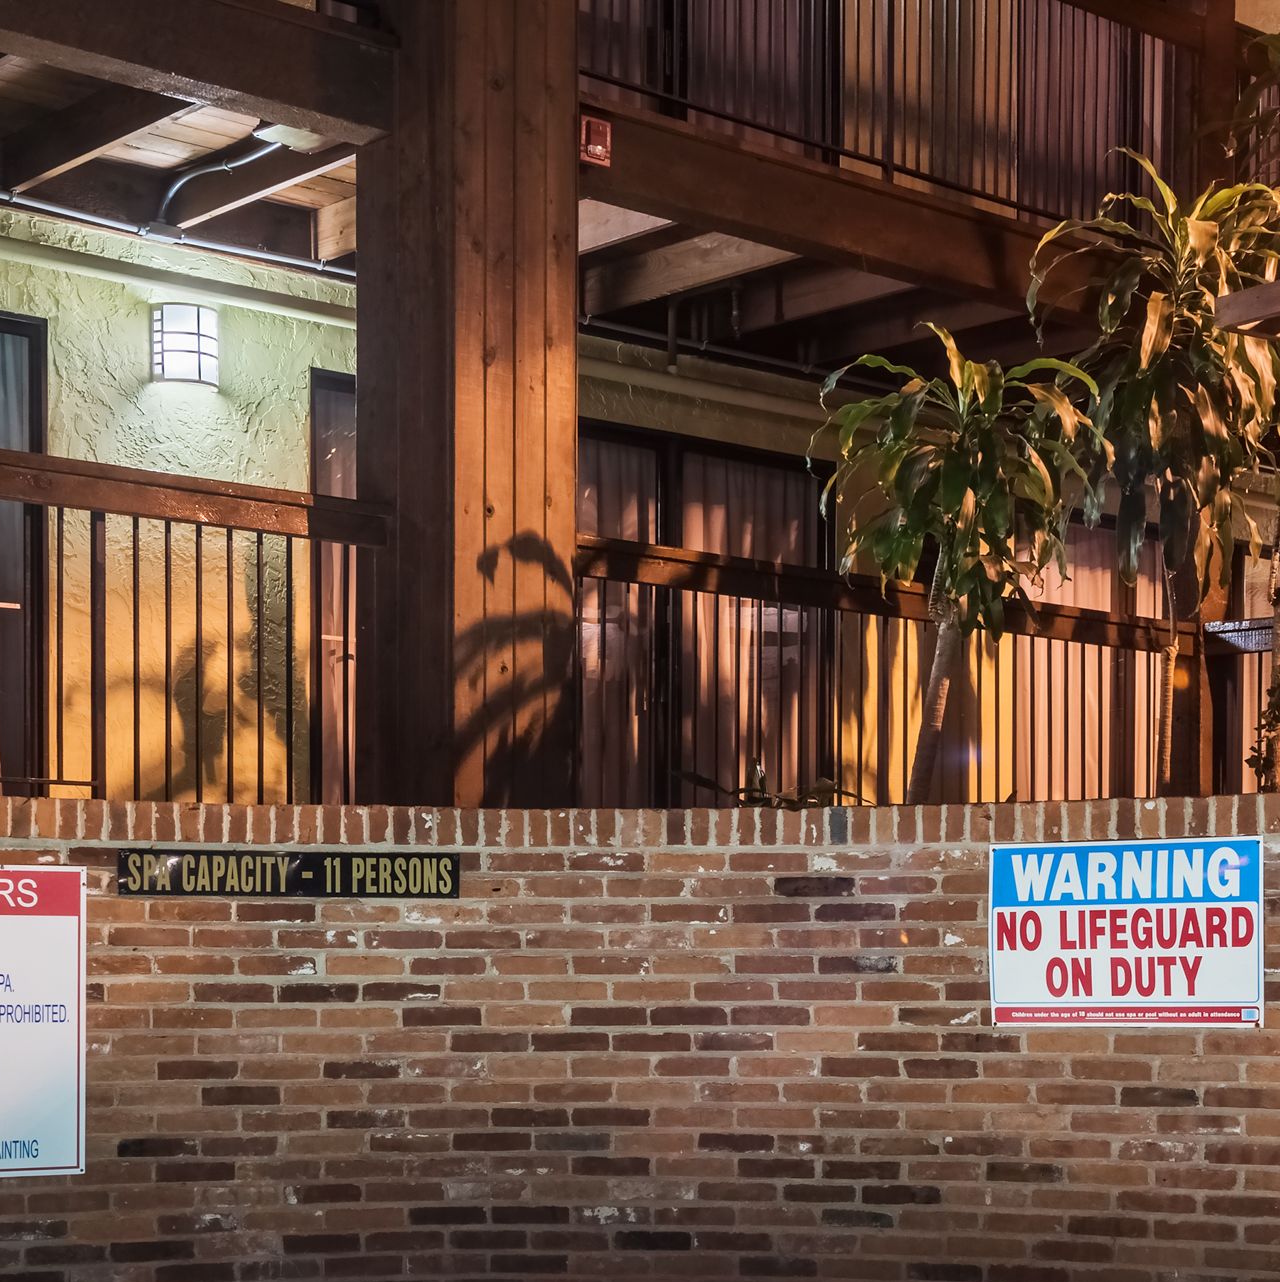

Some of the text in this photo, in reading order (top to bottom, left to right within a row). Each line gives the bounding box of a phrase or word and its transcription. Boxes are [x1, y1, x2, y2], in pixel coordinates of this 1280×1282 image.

[127, 853, 453, 894] SPA CAPACITY - 11 PERSONS
[1011, 847, 1241, 902] WARNING
[996, 906, 1254, 951] NO LIFEGUARD
[1045, 955, 1203, 997] ON DUTY
[0, 1004, 70, 1024] PROHIBITED.
